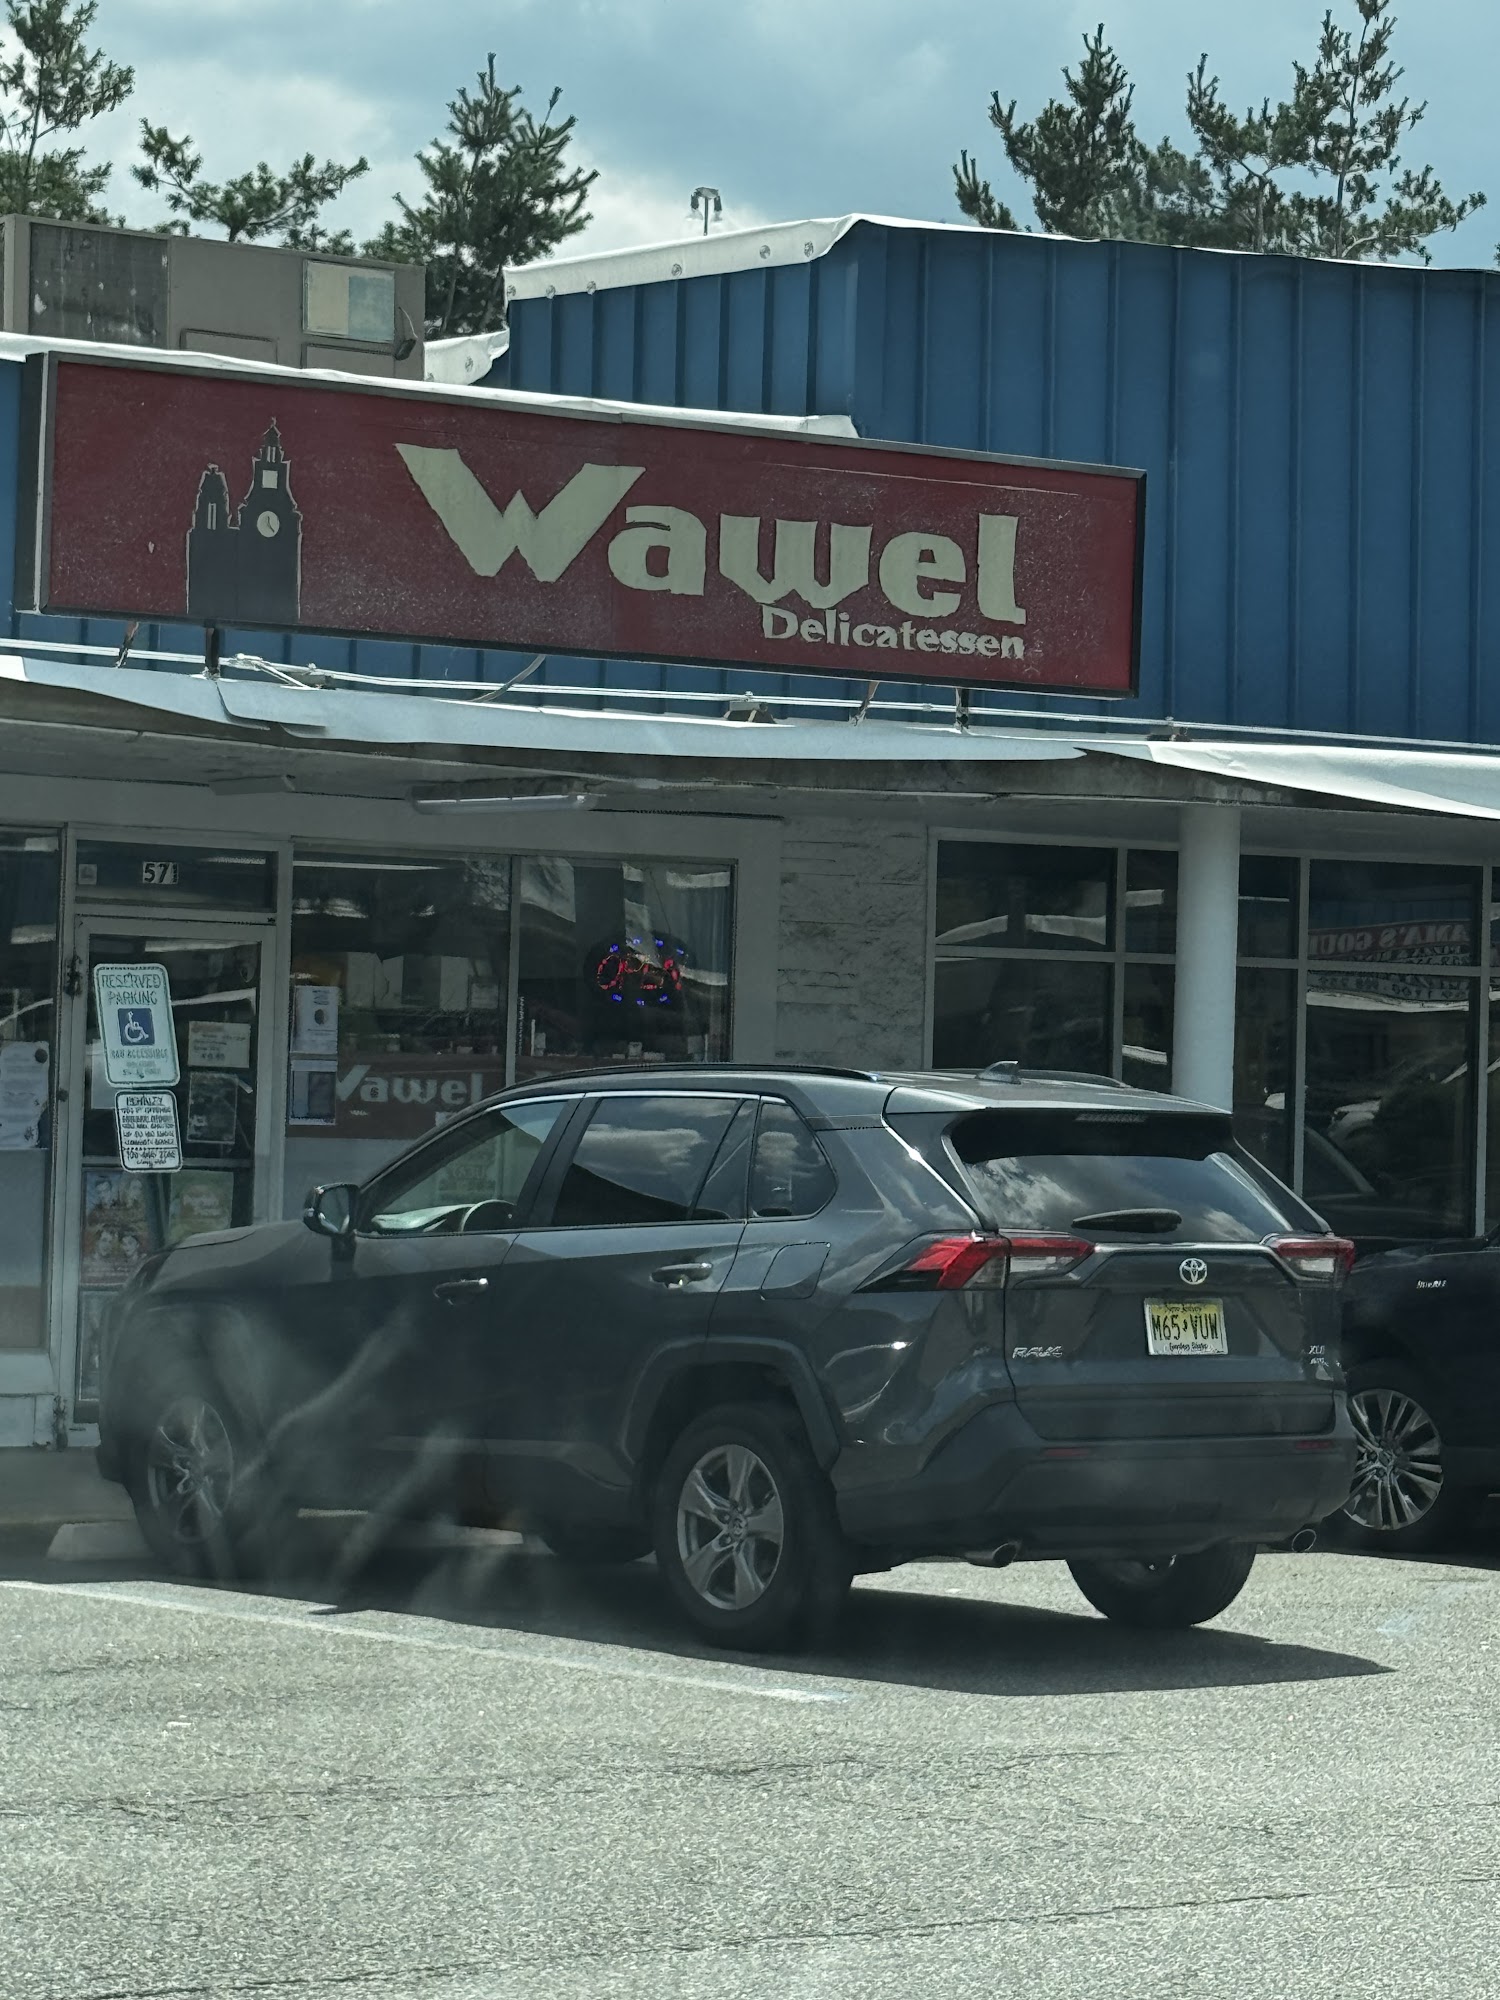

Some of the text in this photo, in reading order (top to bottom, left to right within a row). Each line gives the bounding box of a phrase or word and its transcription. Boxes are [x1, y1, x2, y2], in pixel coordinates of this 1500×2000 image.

[394, 442, 1027, 626] Wawel
[761, 603, 1025, 661] Delicatessen
[144, 863, 178, 884] 571
[101, 973, 162, 989] RESERVED
[107, 990, 158, 1005] PARKING
